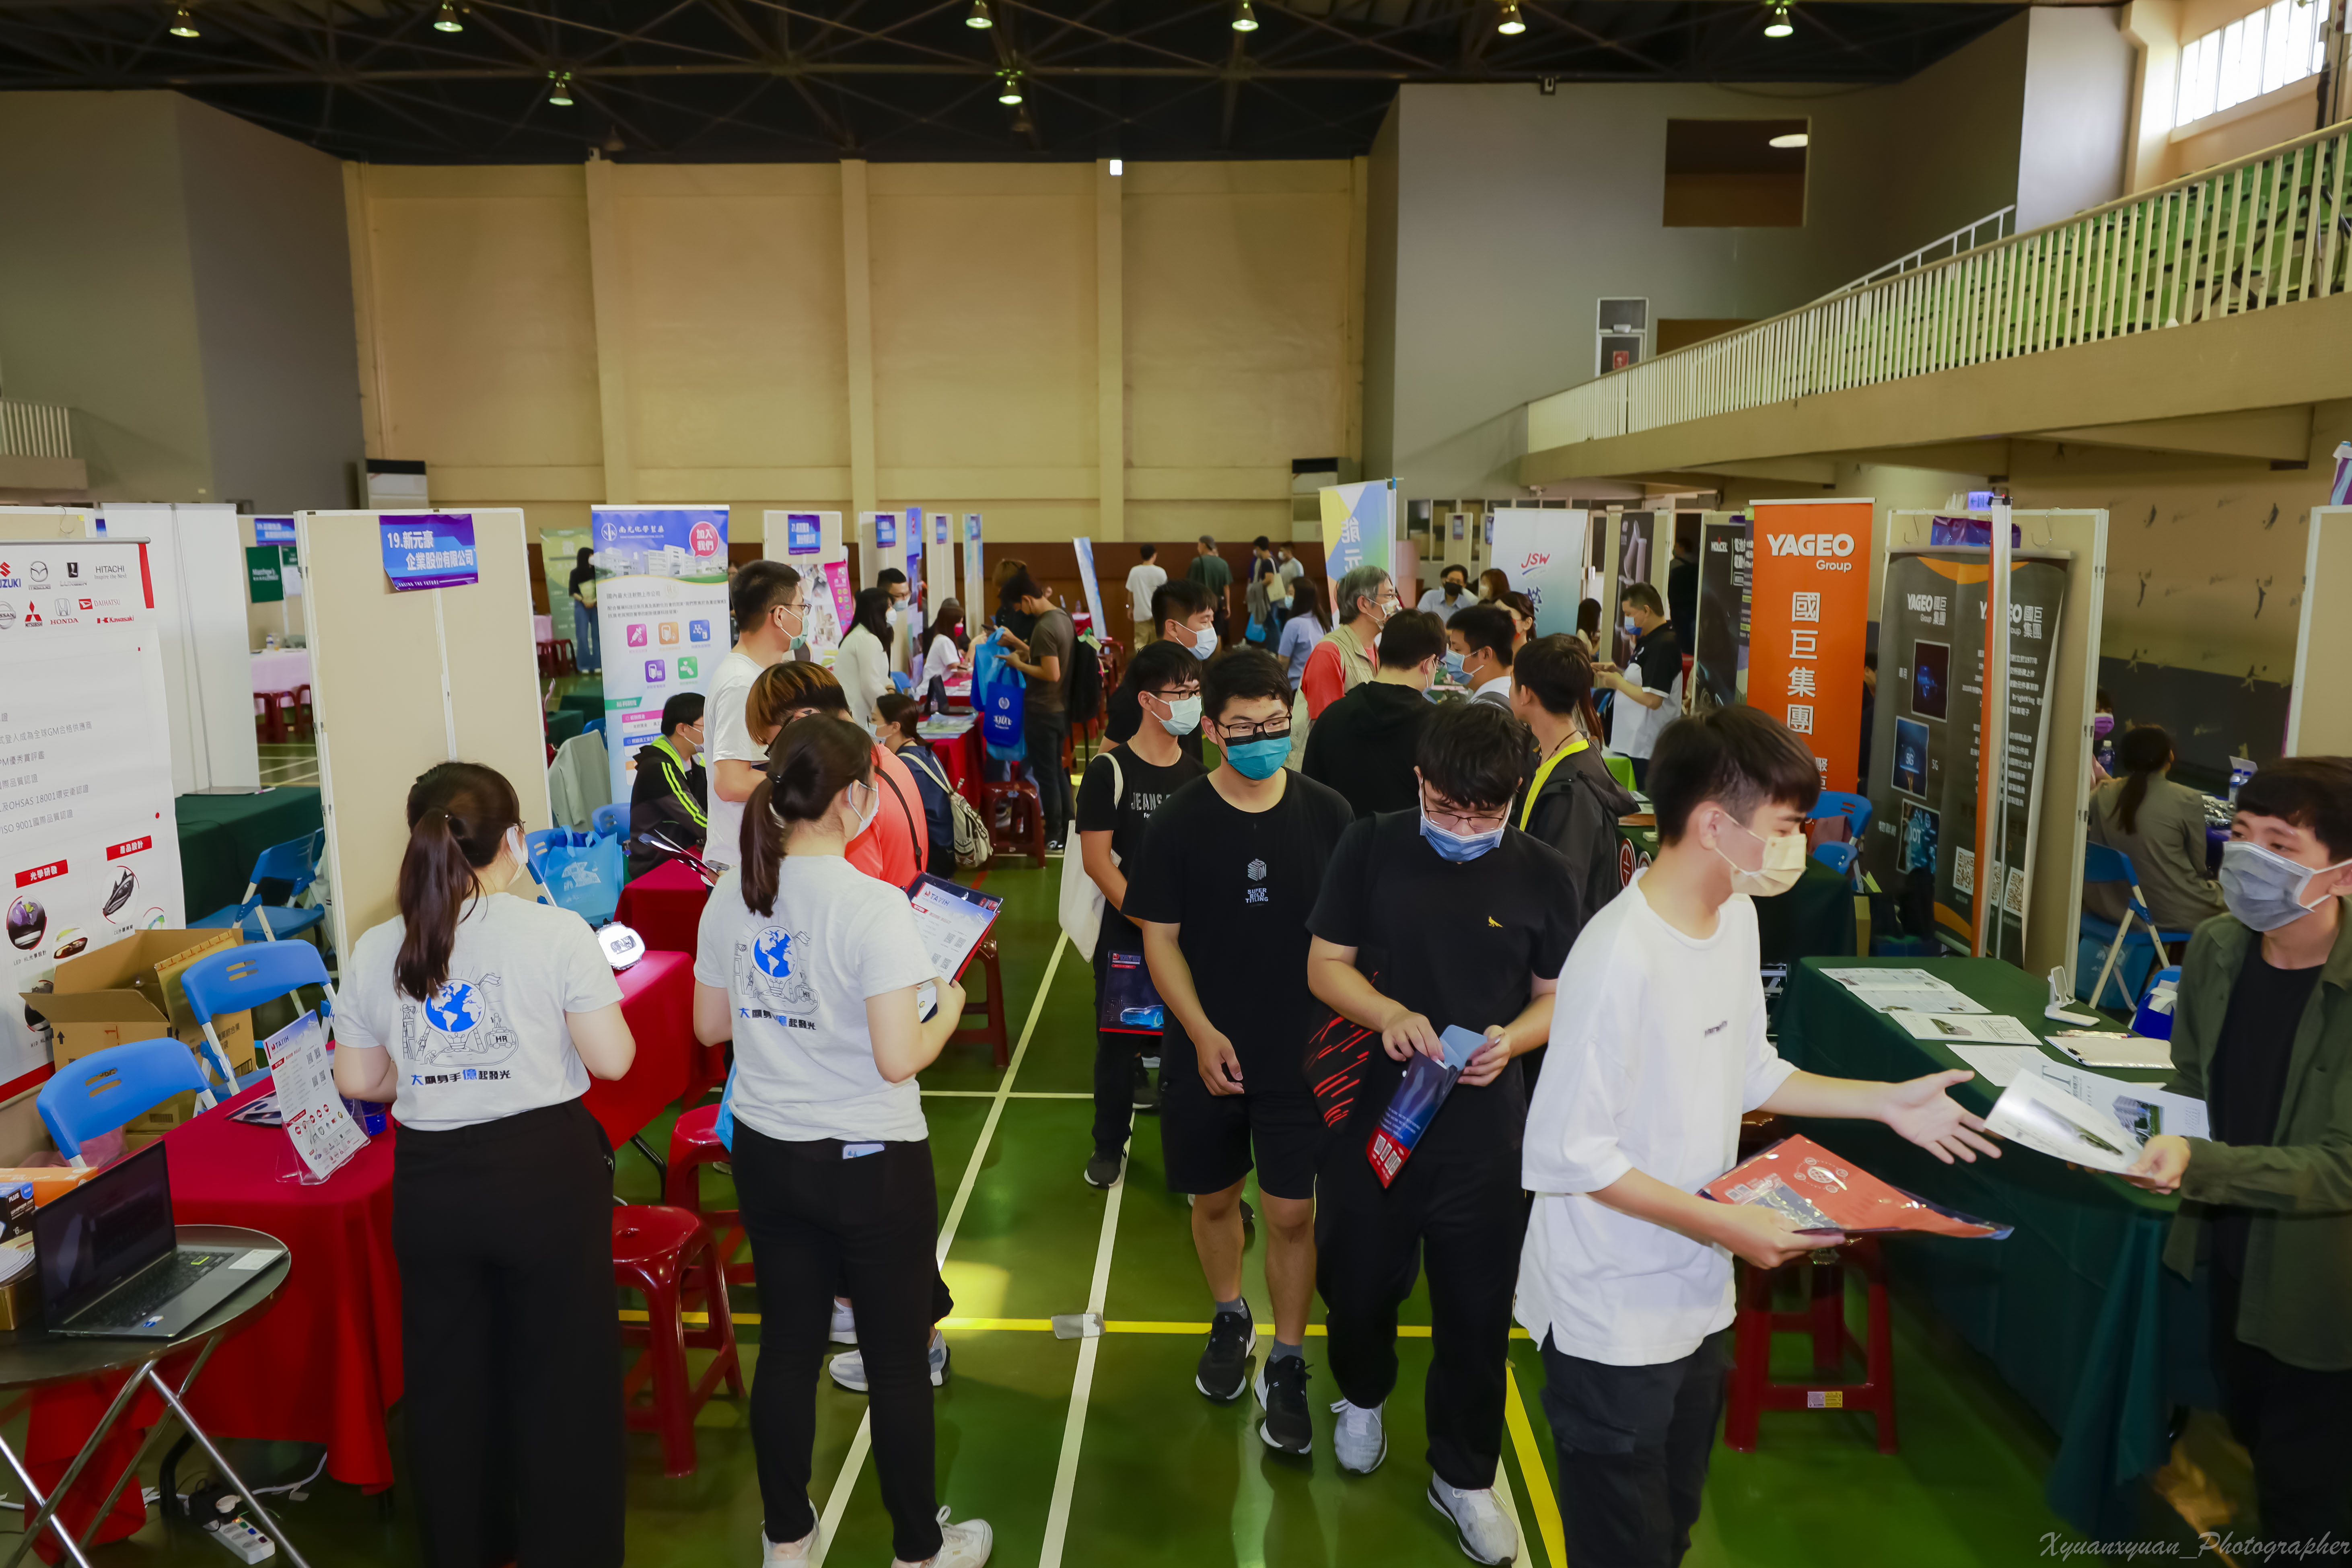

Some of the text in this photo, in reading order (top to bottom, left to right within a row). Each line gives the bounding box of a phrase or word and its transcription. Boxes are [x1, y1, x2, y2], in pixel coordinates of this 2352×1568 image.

[387, 530, 434, 549] 19.新元豪
[697, 529, 712, 539] 加入
[697, 540, 714, 551] 我們
[1766, 533, 1855, 557] YAGEO
[405, 549, 474, 571] 企業股份有限公司
[1521, 553, 1550, 568] JSW
[1816, 560, 1852, 573] Group
[95, 565, 125, 573] HITACHI
[94, 599, 121, 607] DAIHATSU
[1908, 593, 1947, 613] YAGEO 國巨
[109, 615, 135, 623] Kawasaki
[1920, 613, 1932, 624] Group
[1932, 611, 1947, 626] 集團
[2024, 605, 2043, 623] 國巨
[2023, 622, 2042, 640] 集團
[1787, 591, 1821, 735] 國巨集團
[0, 712, 8, 722] 證
[1905, 752, 1914, 766] 5G
[1932, 759, 1939, 771] 5G
[15, 809, 74, 831] 9001國際品質認證
[931, 893, 950, 907] TAYIH
[276, 1035, 289, 1049] TAYIH
[8, 1193, 20, 1203] PLUS
